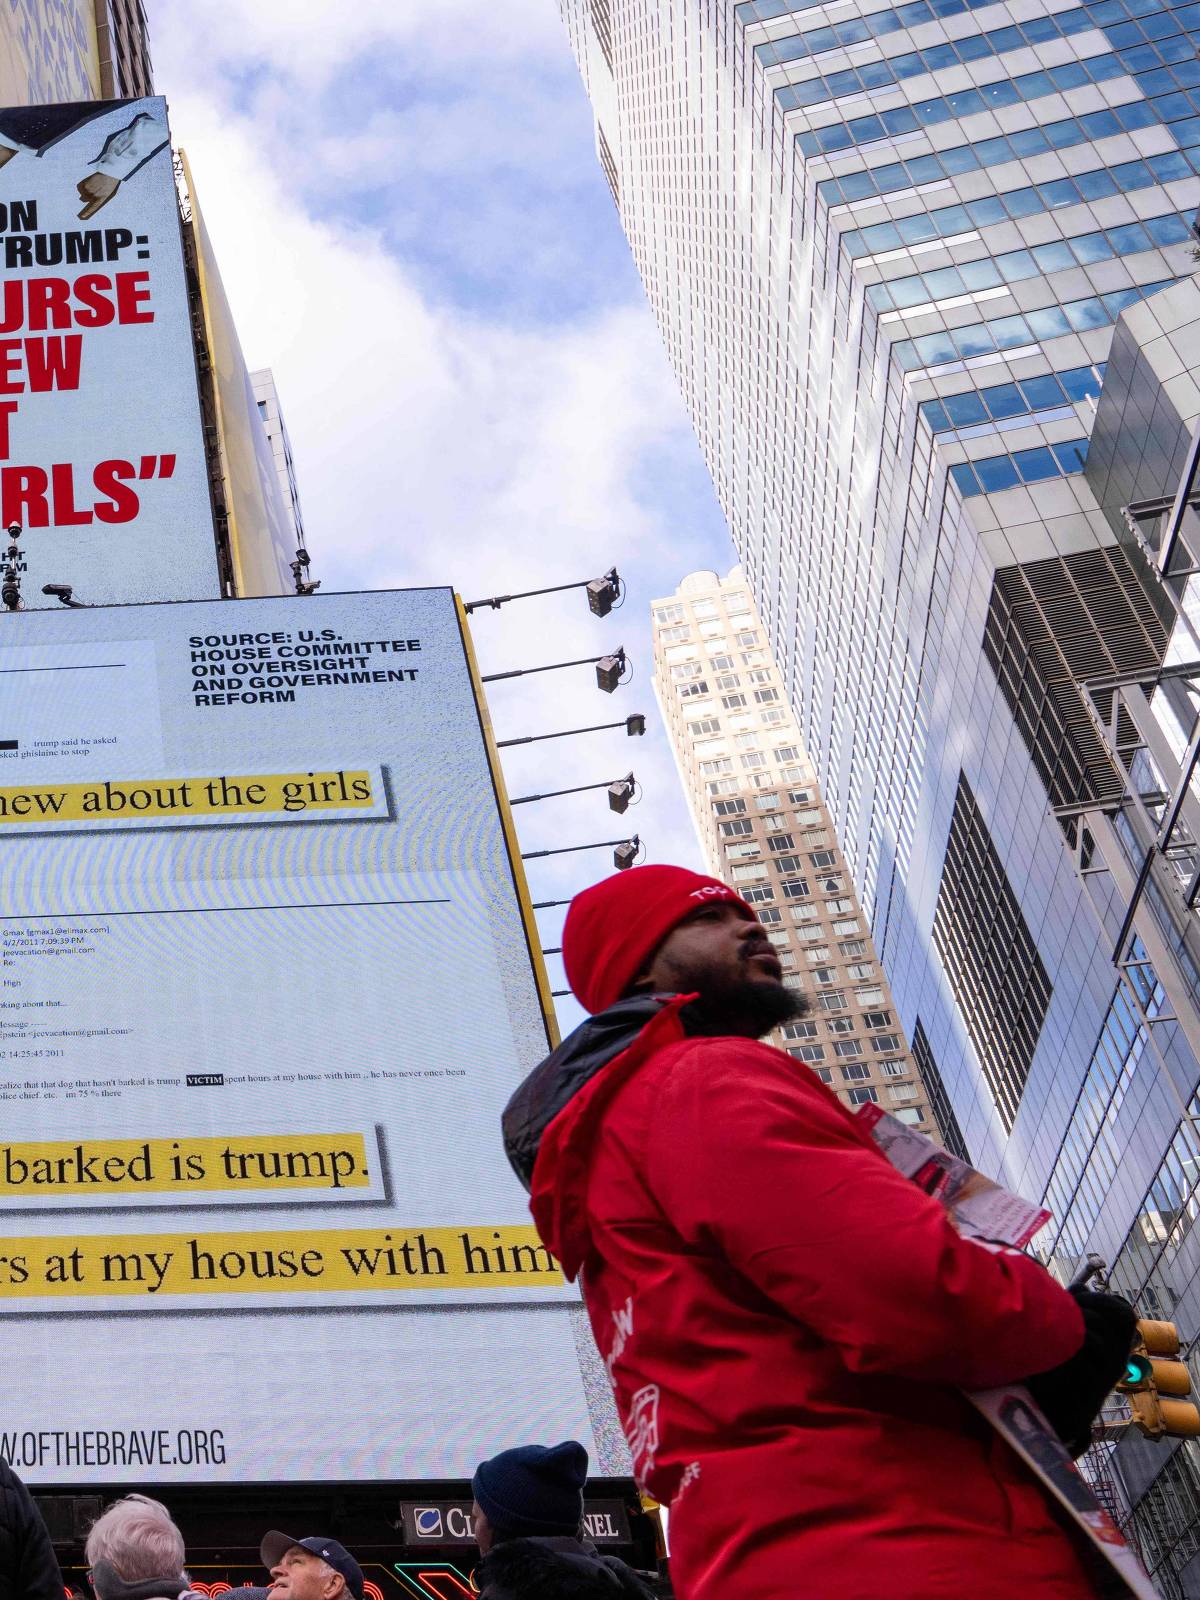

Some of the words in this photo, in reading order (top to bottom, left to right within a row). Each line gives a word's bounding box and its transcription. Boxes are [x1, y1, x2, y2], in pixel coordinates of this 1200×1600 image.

[189, 632, 292, 648] SOURCE:
[298, 629, 343, 642] U.S.
[190, 647, 272, 662] HOUSE
[277, 639, 421, 658] COMMITTEE
[191, 664, 226, 676] ON
[232, 657, 369, 675] OVERSIGHT
[192, 678, 242, 691] AND
[249, 669, 419, 688] GOVERNMENT
[194, 690, 295, 706] REFORM
[21, 748, 59, 759] ghislaine
[72, 748, 90, 757] stop
[34, 740, 59, 749] trump
[62, 738, 79, 746] said
[93, 736, 117, 744] asked
[82, 782, 194, 812] about
[203, 776, 266, 807] the
[282, 771, 371, 812] girls
[41, 1081, 56, 1089] that
[58, 1080, 74, 1090] dog
[75, 1080, 91, 1088] that
[118, 1078, 145, 1086] barked
[156, 1078, 181, 1087] trump
[188, 1076, 223, 1085] VICTIM
[224, 1075, 246, 1084] spent
[248, 1074, 271, 1082] hours
[297, 1073, 322, 1081] house
[324, 1072, 342, 1080] with
[344, 1071, 361, 1079] him
[445, 1068, 465, 1076] been
[2, 1143, 155, 1185] barked
[169, 1142, 207, 1181] is
[219, 1143, 370, 1188] trump.
[45, 1245, 85, 1283] at
[100, 1250, 174, 1293] my
[187, 1239, 324, 1281] house
[341, 1233, 449, 1276] with
[458, 1232, 559, 1274] him
